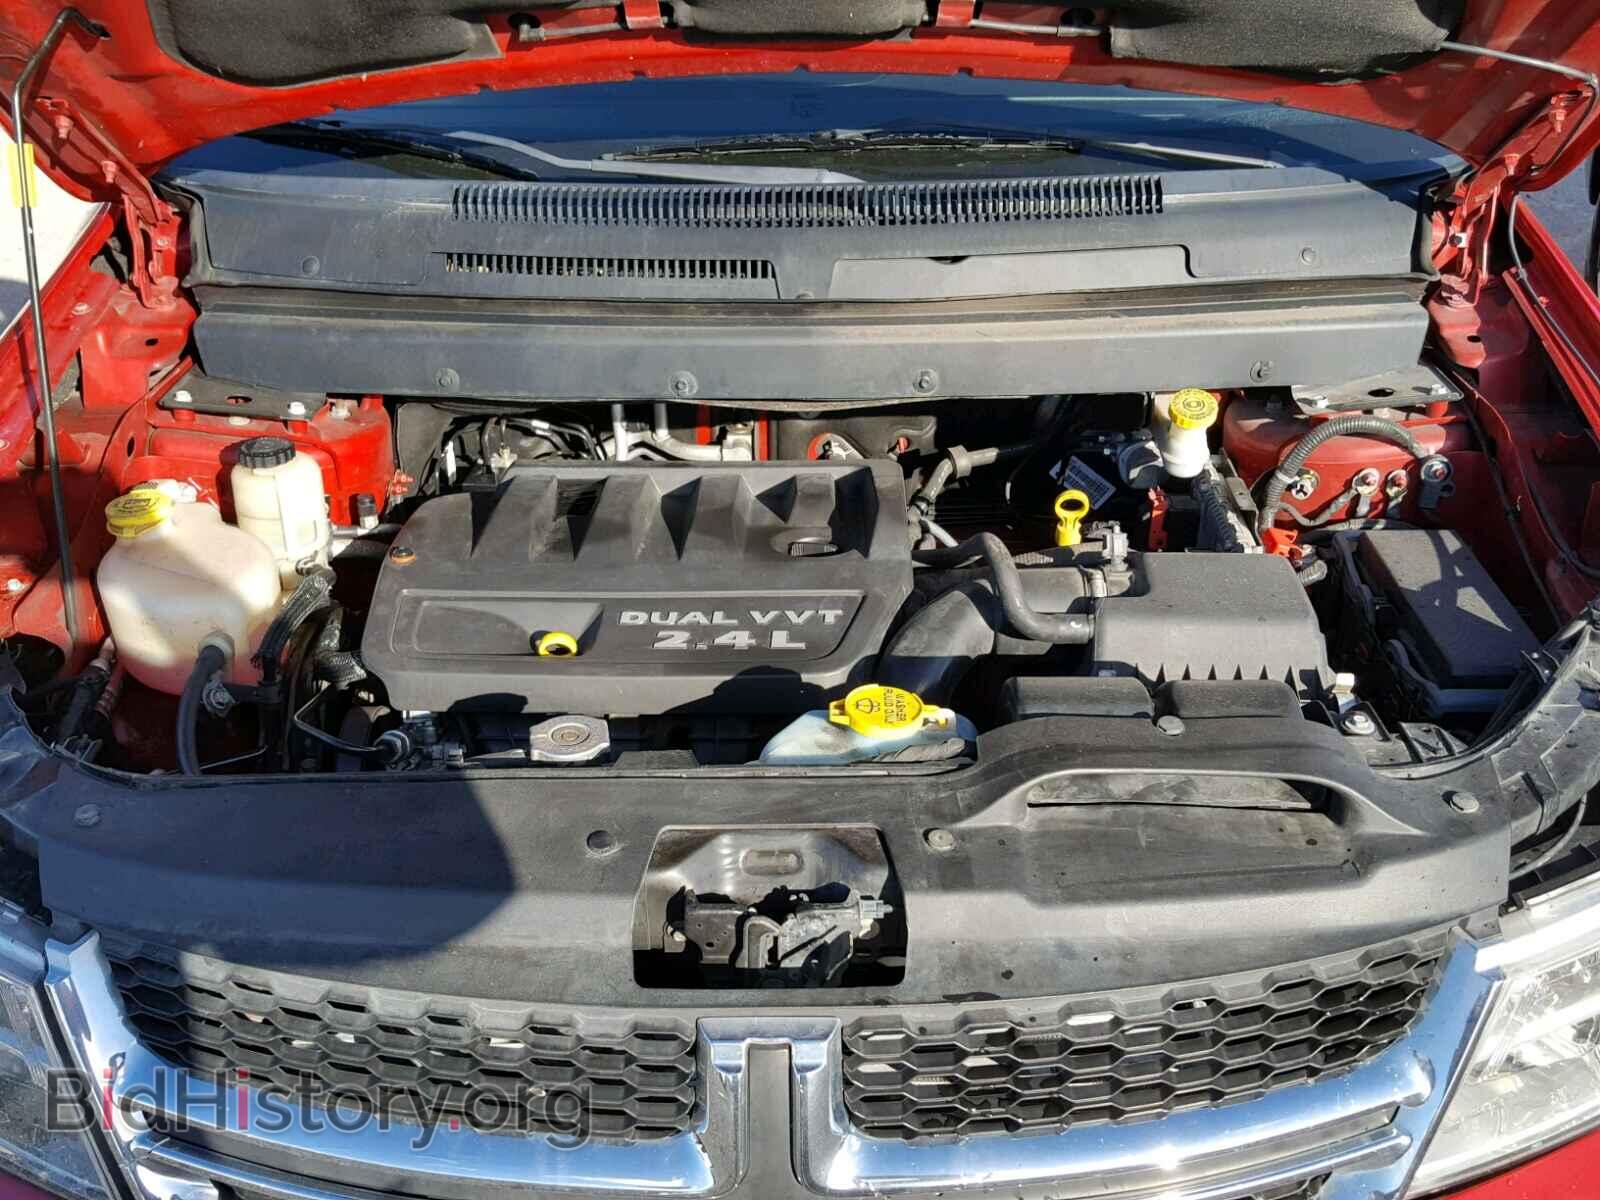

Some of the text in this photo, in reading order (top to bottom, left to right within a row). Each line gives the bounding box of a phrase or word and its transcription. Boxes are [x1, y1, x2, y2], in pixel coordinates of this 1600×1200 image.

[618, 609, 844, 625] DUAL VVT
[883, 688, 894, 724] FLUID ONLY
[895, 693, 907, 722] WASHER
